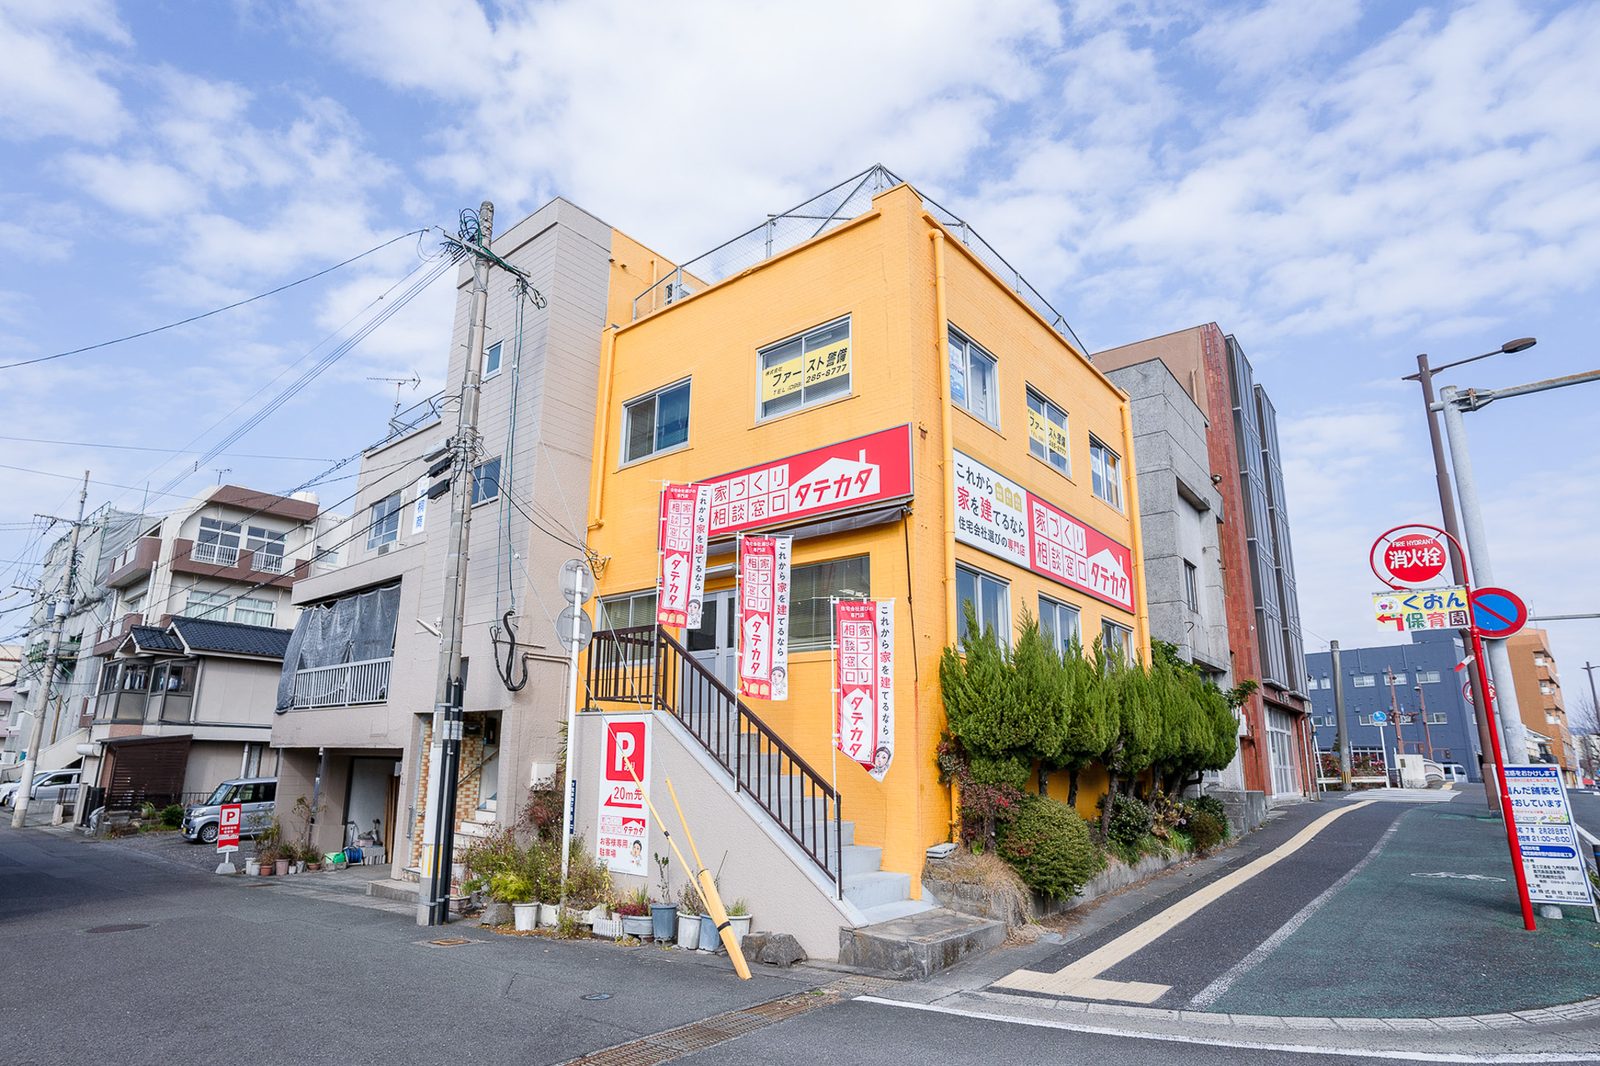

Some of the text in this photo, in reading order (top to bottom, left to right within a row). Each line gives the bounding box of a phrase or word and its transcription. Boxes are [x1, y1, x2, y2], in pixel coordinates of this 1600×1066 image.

[714, 468, 785, 502] 家づくり
[794, 468, 874, 507] タテカタ
[956, 462, 994, 495] これから
[712, 494, 786, 526] 相談窓口
[957, 486, 1026, 538] 家を建てるなら
[1035, 508, 1084, 552] 家づくり
[694, 488, 709, 592] これから家を建てるなら
[958, 516, 1026, 557] 住宅会社選びの専門店
[1406, 538, 1434, 546] HYDRANT
[1037, 540, 1087, 582] 相談窓口
[1388, 546, 1442, 569] 消火栓
[669, 559, 682, 606] タテカタ
[759, 558, 770, 611] 家づくり
[776, 542, 788, 657] これから家を建てるなら
[1090, 562, 1127, 600] タテカタ
[1403, 592, 1466, 610] くおん
[1405, 610, 1469, 629] 保育園
[750, 620, 762, 675] タテカタ
[844, 624, 856, 683] 相談窓口
[858, 624, 871, 684] 家づくり
[880, 606, 891, 736] これから家を建てるなら
[850, 696, 863, 758] タテカタ
[614, 731, 636, 772] P
[226, 812, 236, 822] P
